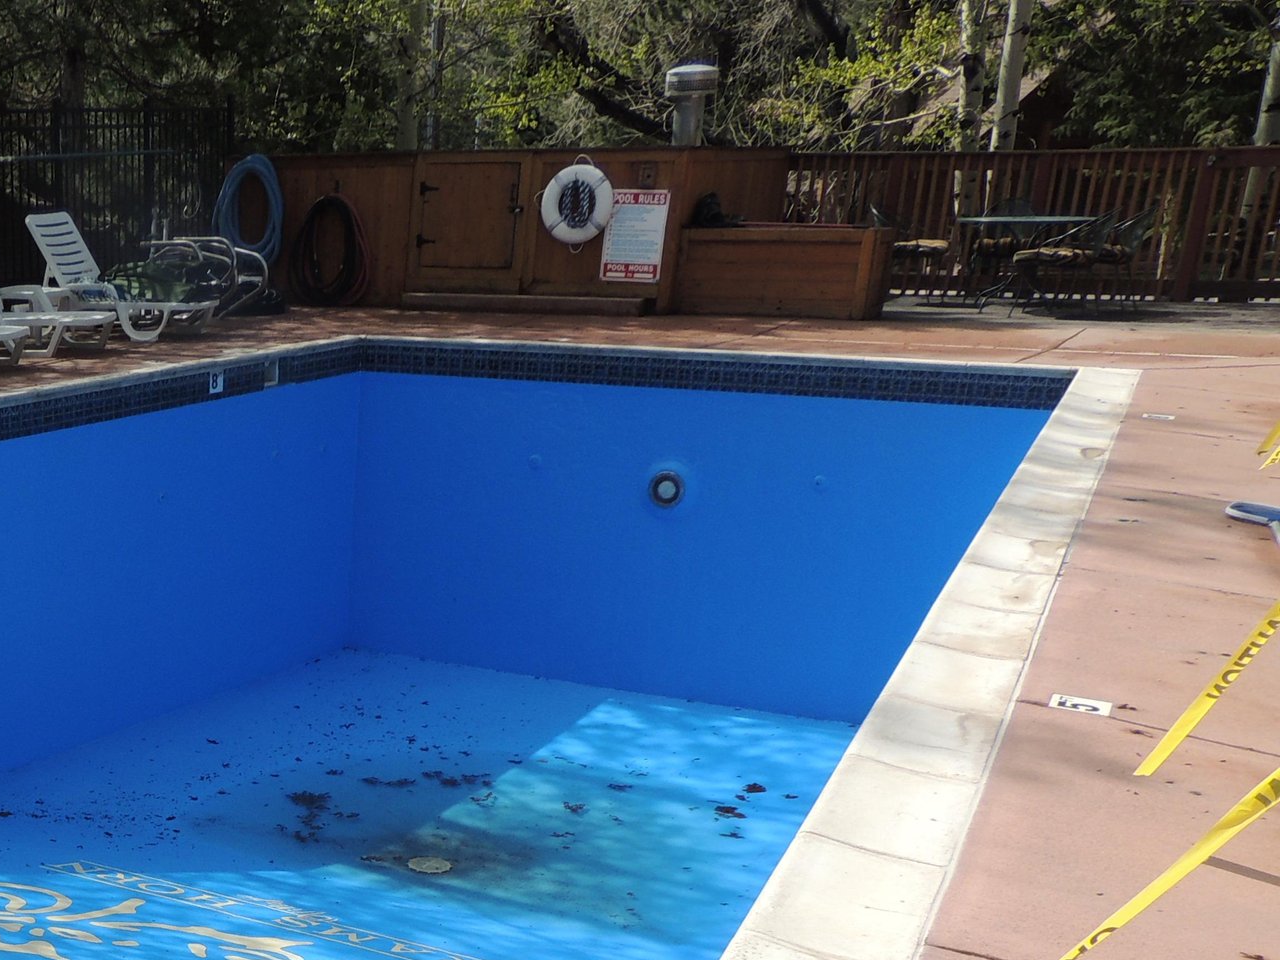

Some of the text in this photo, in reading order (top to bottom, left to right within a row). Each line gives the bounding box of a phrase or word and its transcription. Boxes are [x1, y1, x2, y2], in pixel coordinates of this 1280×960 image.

[614, 194, 665, 204] POOL RULES
[607, 263, 654, 273] POOL HOURS
[212, 373, 218, 389] 8
[57, 861, 238, 908] HORN
